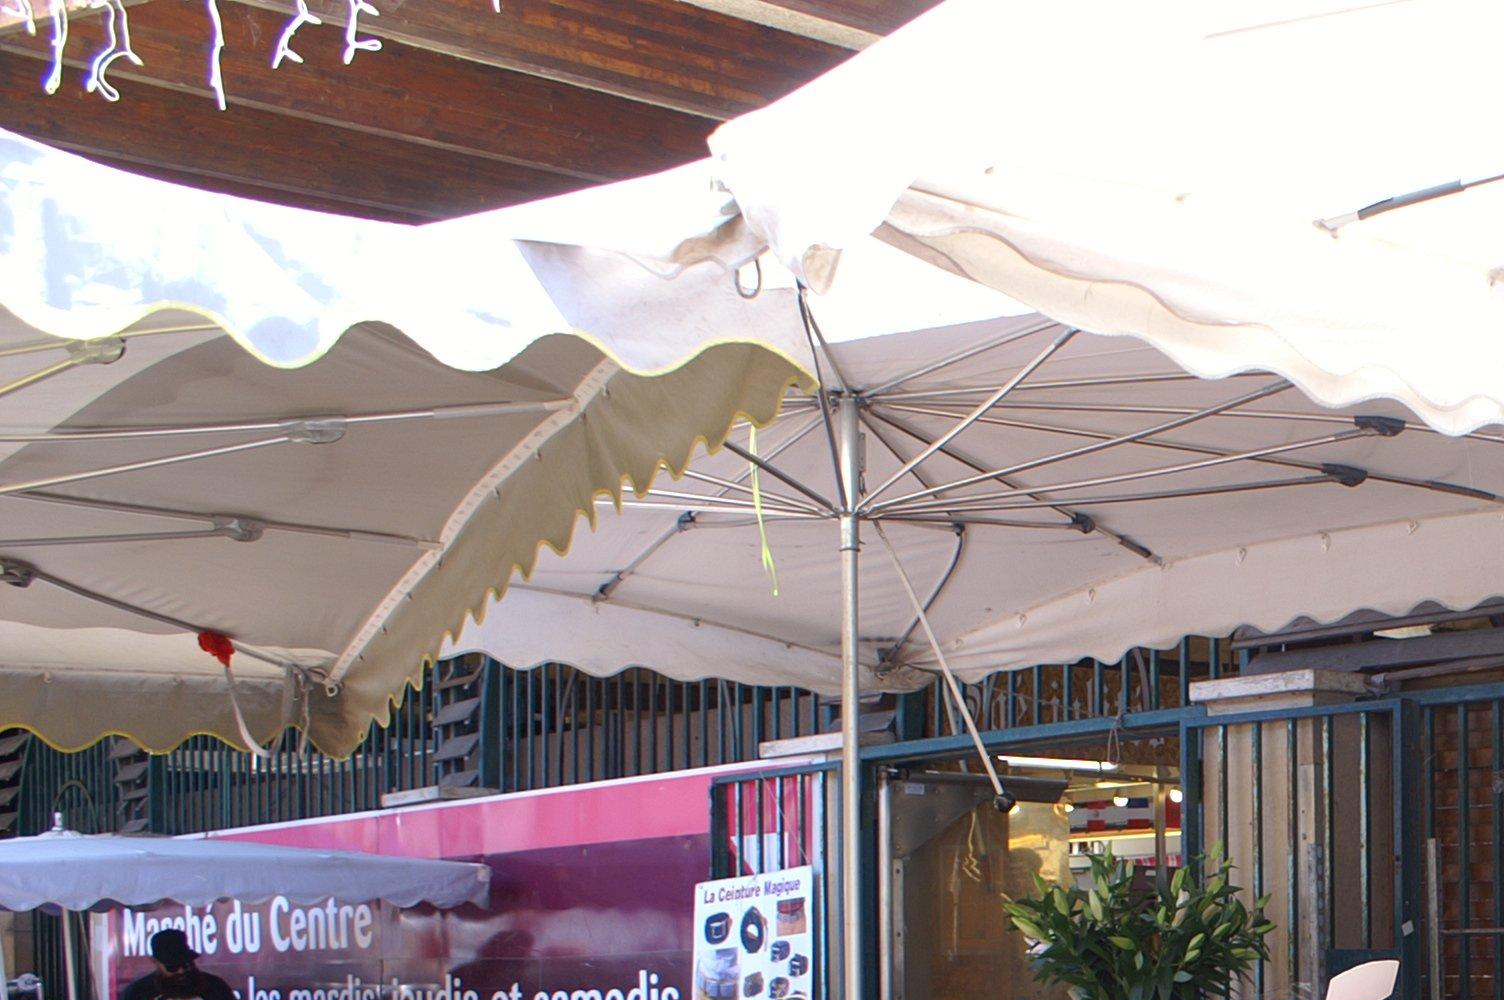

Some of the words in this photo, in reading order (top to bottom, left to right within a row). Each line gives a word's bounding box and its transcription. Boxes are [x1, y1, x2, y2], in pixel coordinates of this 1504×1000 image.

[703, 890, 715, 904] La
[764, 878, 801, 896] Magique
[226, 899, 260, 953] du
[269, 896, 373, 951] Centre
